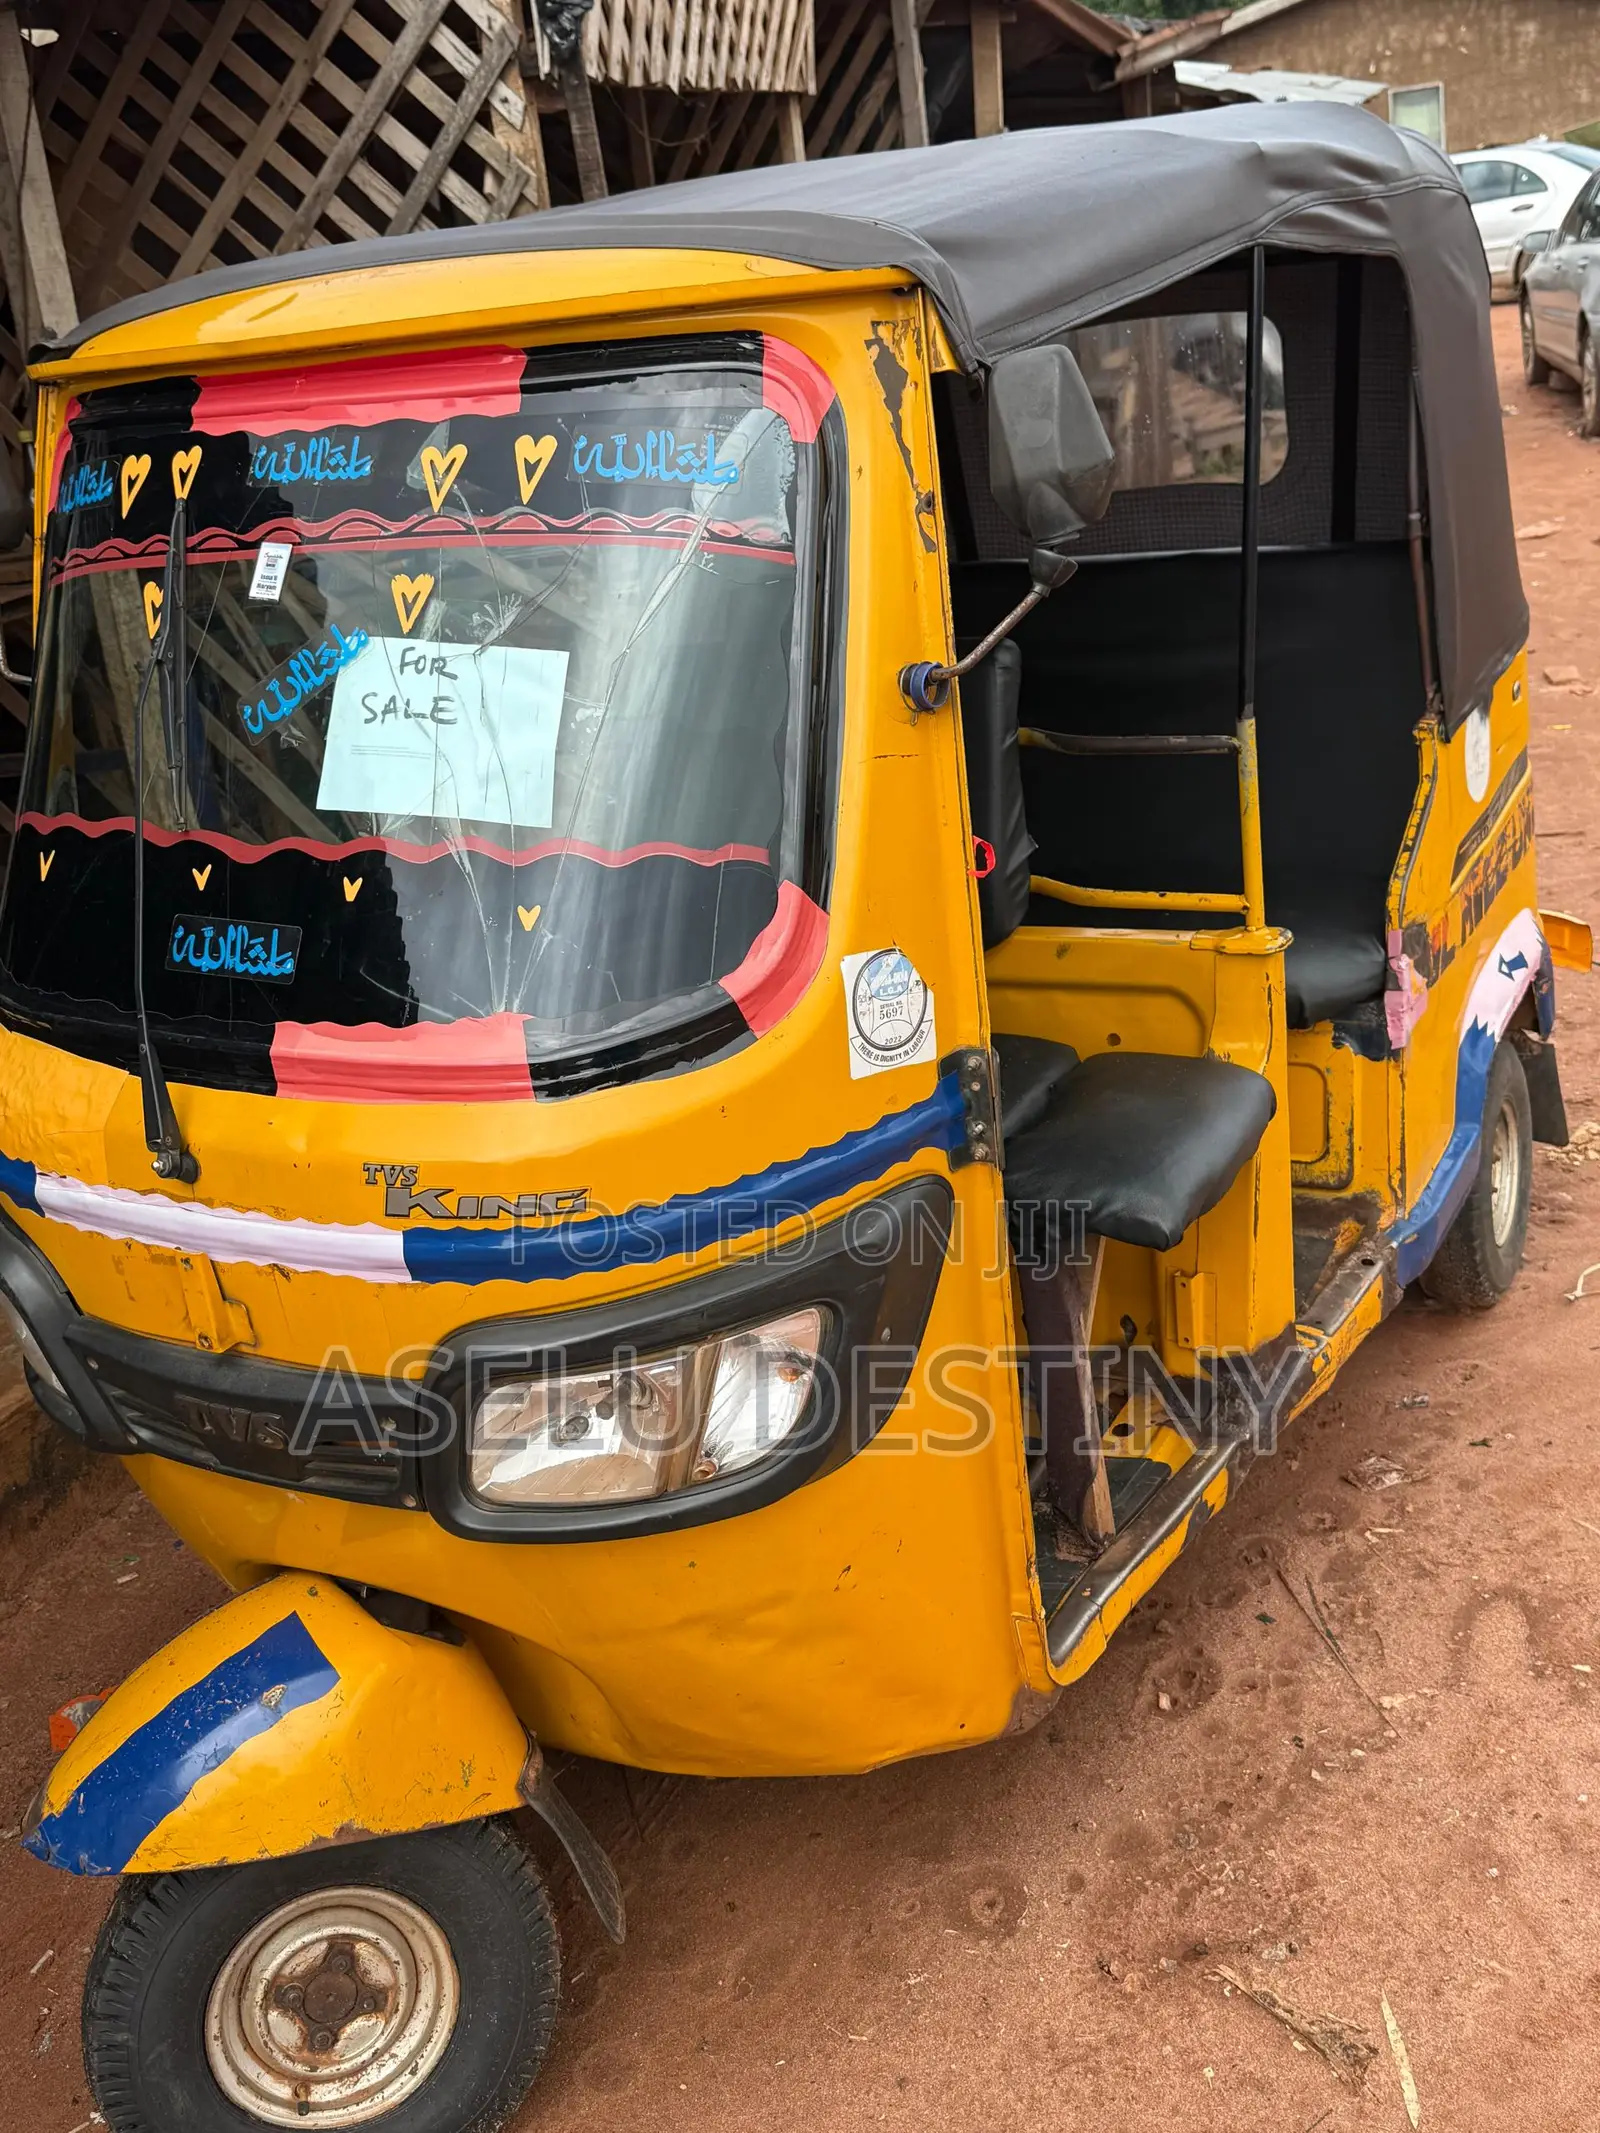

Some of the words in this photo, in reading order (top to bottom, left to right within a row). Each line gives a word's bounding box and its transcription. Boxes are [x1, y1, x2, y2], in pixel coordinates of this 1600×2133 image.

[399, 646, 459, 680] FOR
[361, 692, 458, 725] SALE
[879, 1006, 904, 1020] 5697
[858, 1042, 874, 1059] THERE
[873, 1054, 880, 1062] IS
[879, 1053, 902, 1063] DIGNITY
[903, 1050, 910, 1059] IN
[910, 1029, 926, 1053] LABOUR
[884, 1035, 902, 1045] 2022
[363, 1163, 418, 1186] TVS
[385, 1187, 589, 1219] KING
